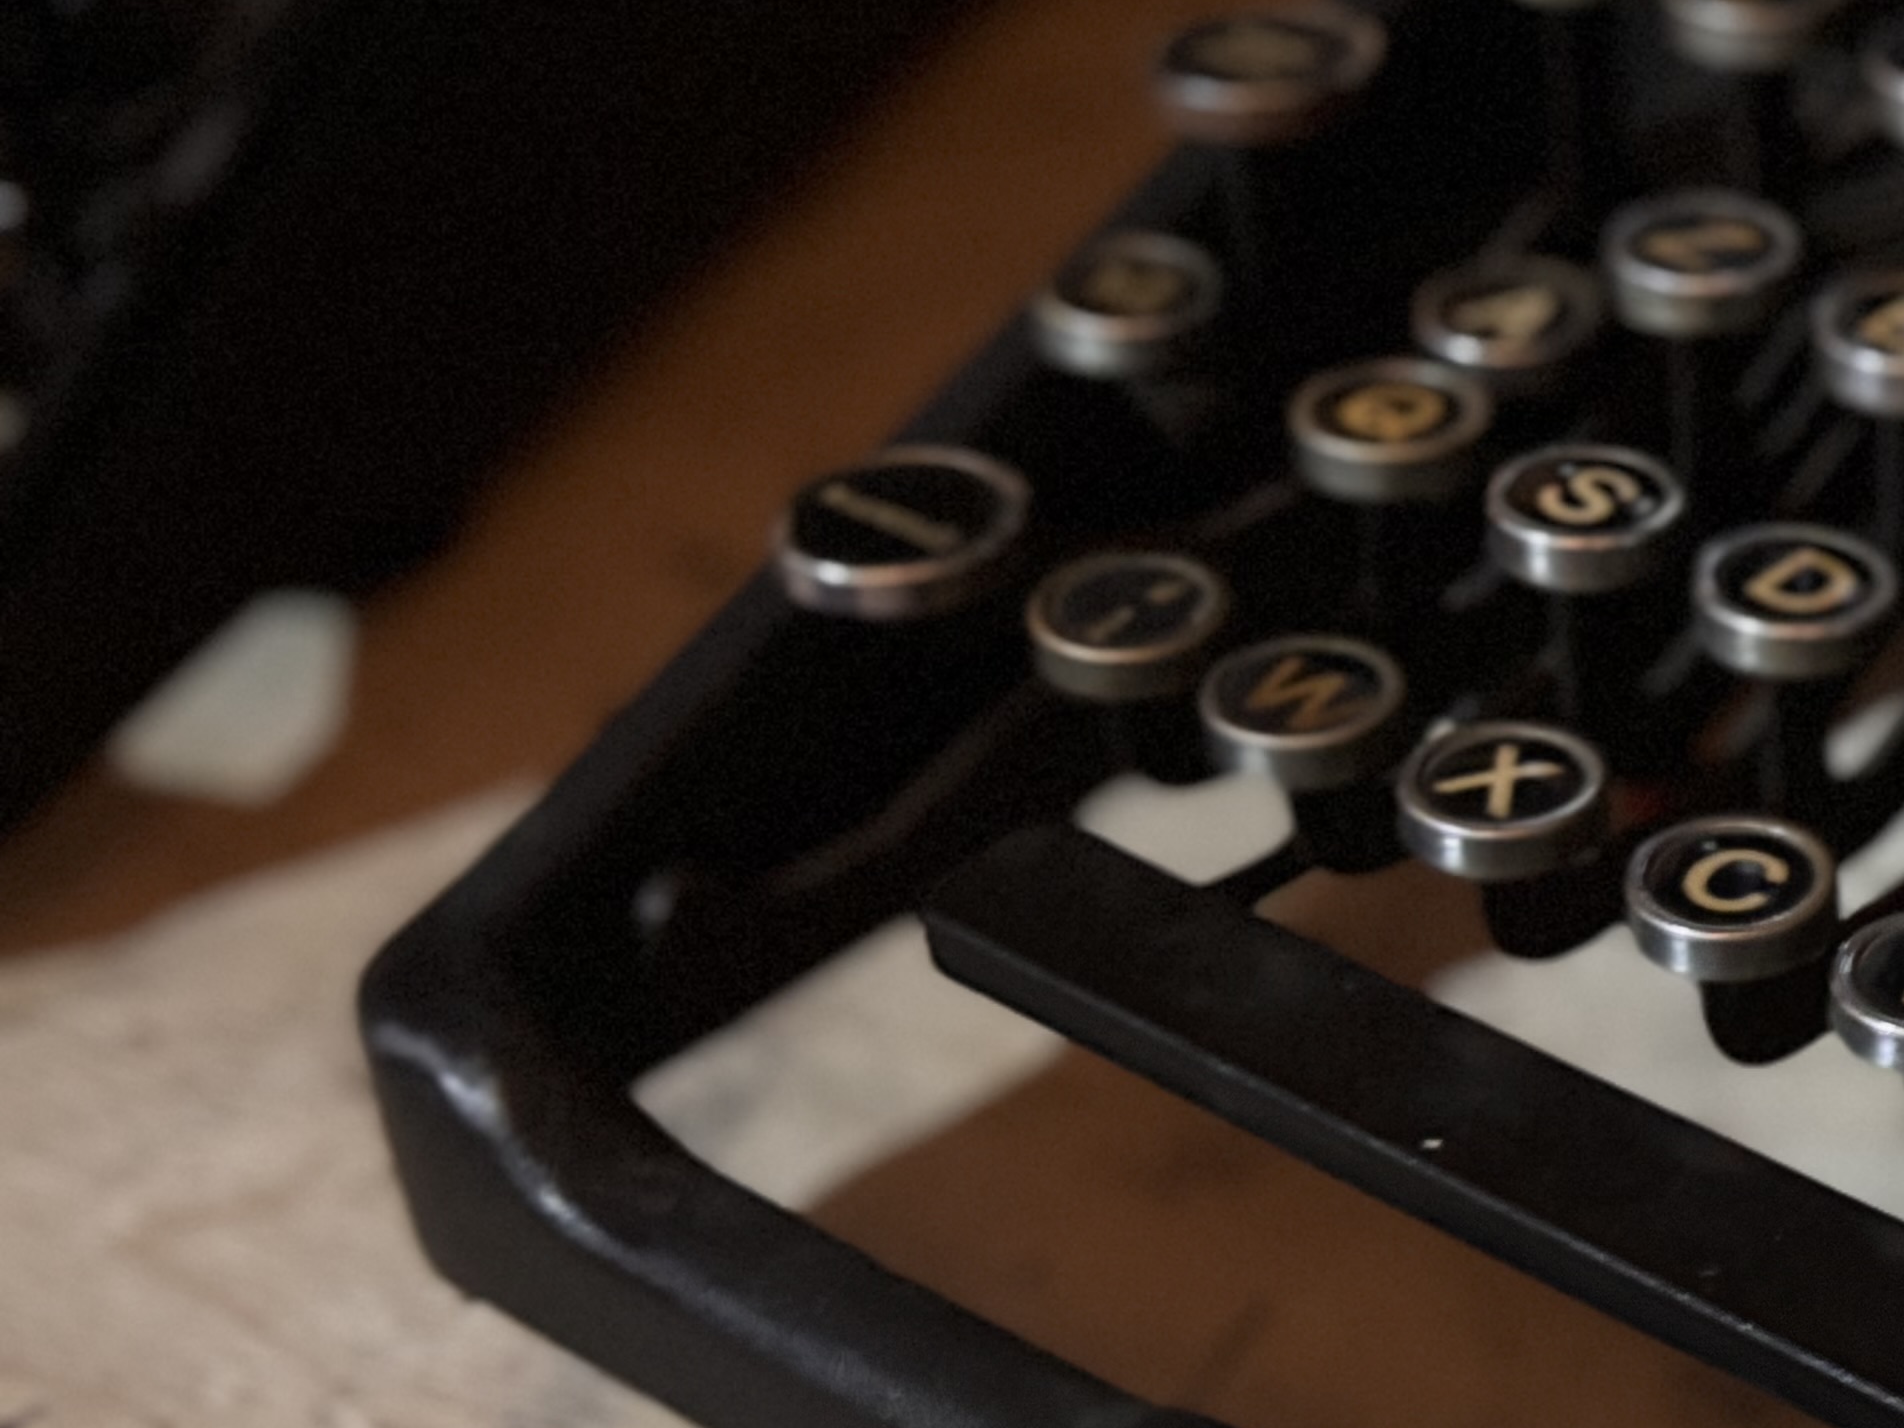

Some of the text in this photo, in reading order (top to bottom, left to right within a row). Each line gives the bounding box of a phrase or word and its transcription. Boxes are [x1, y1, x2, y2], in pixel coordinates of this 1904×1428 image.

[1536, 462, 1644, 527] S
[1745, 546, 1859, 615] D
[1432, 743, 1566, 818] X
[1680, 848, 1791, 914] C
